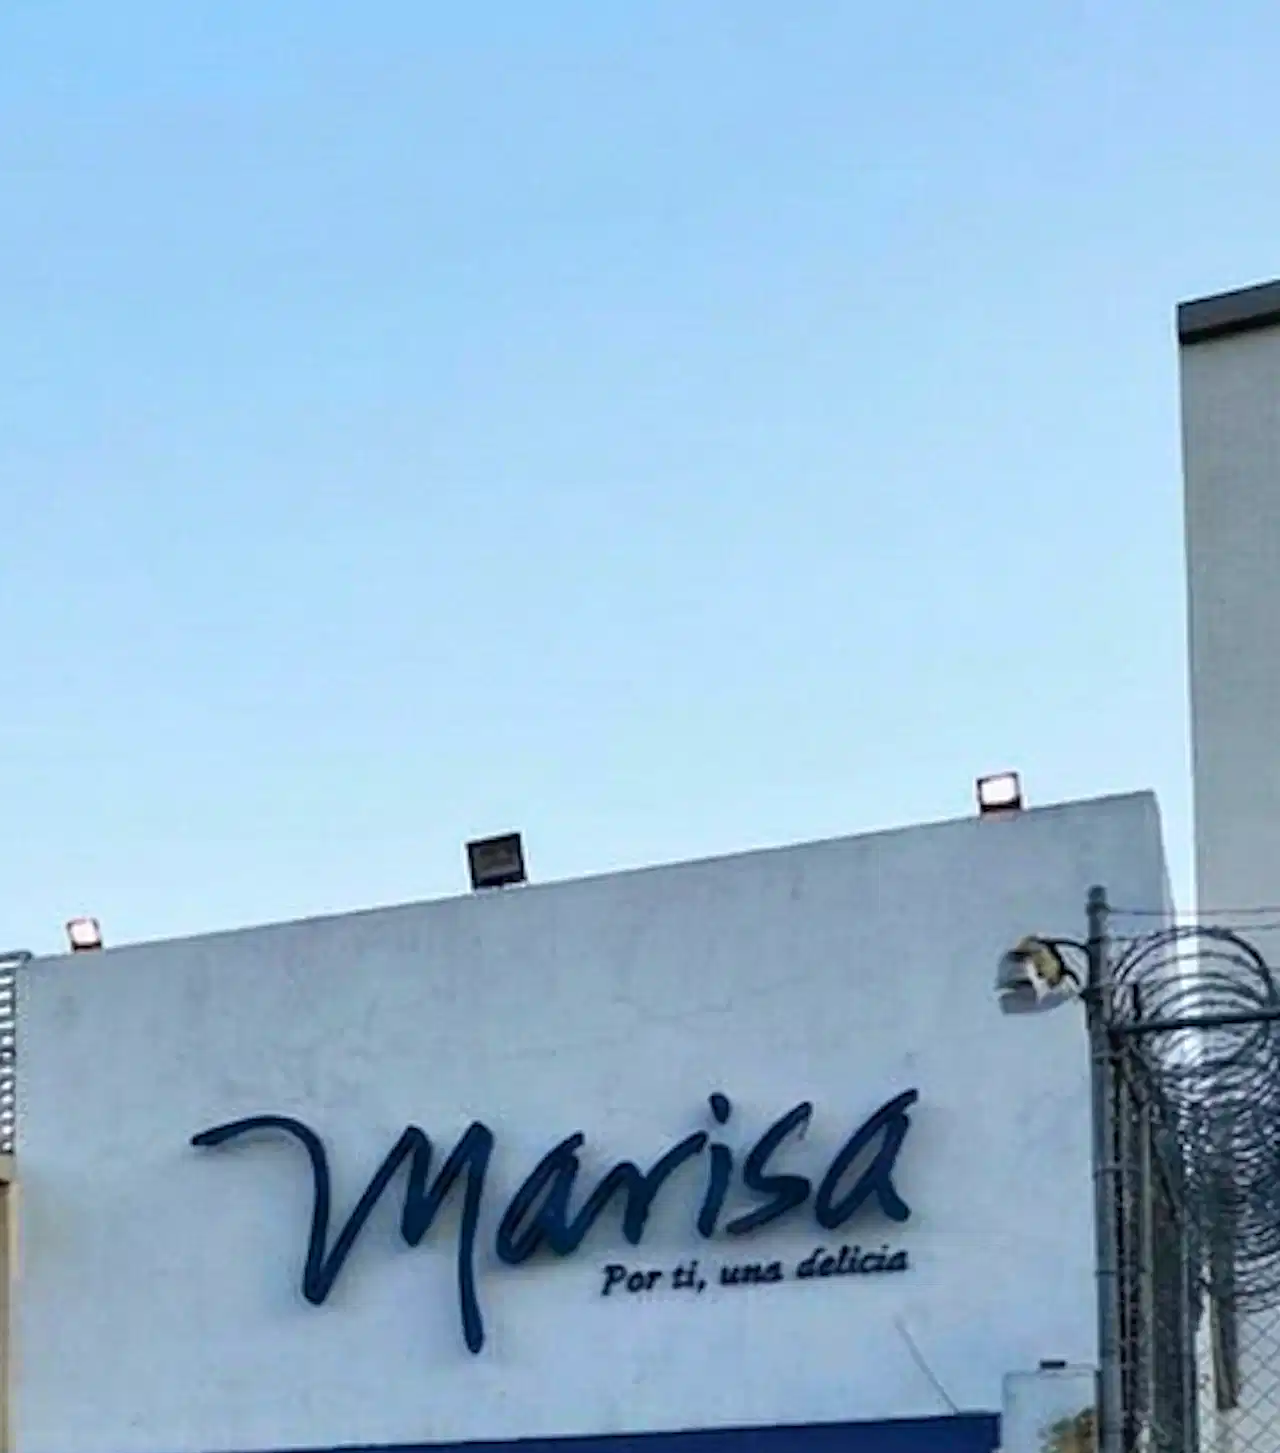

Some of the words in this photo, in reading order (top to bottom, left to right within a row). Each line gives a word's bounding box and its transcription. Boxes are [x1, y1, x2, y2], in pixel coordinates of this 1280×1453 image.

[191, 1089, 919, 1354] Marisa
[601, 1264, 662, 1297] Por
[720, 1262, 783, 1287] una
[796, 1246, 908, 1281] delicia
